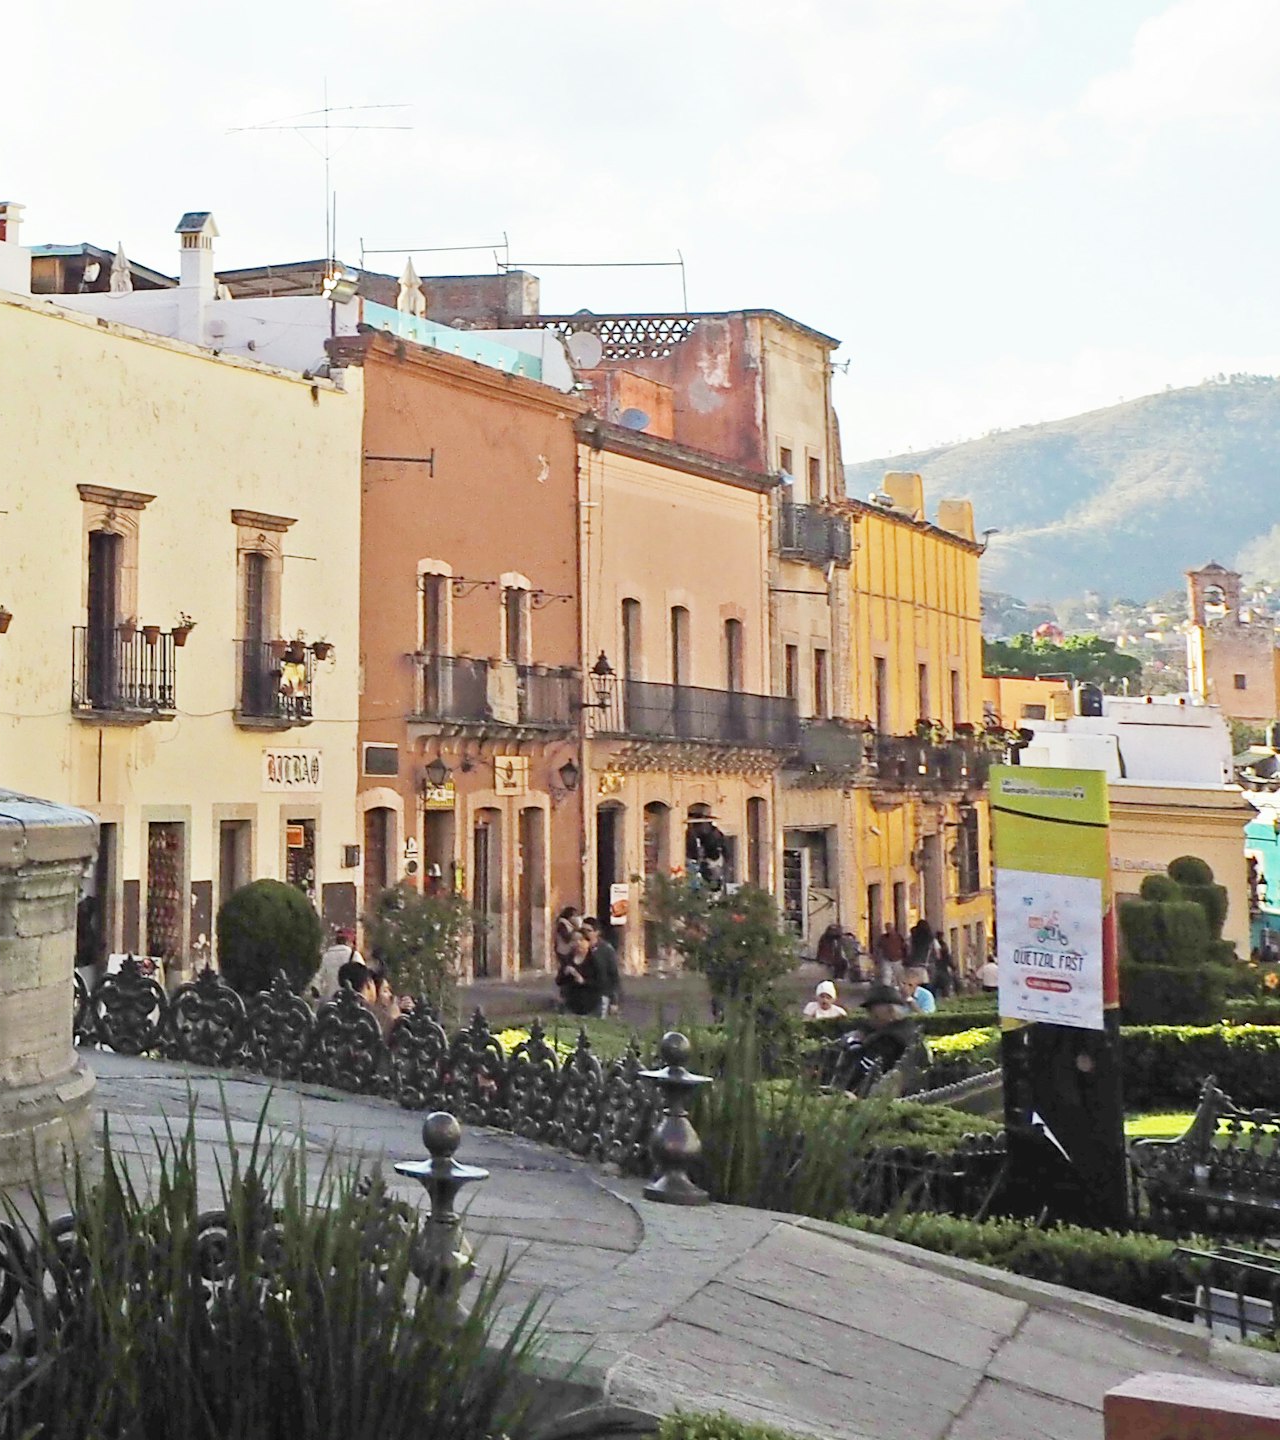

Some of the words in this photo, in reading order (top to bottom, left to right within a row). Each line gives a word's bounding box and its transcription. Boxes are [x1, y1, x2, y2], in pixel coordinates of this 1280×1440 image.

[266, 753, 320, 785] BILBAO
[1013, 949, 1056, 969] QUETZAL
[1059, 955, 1084, 972] FAST
